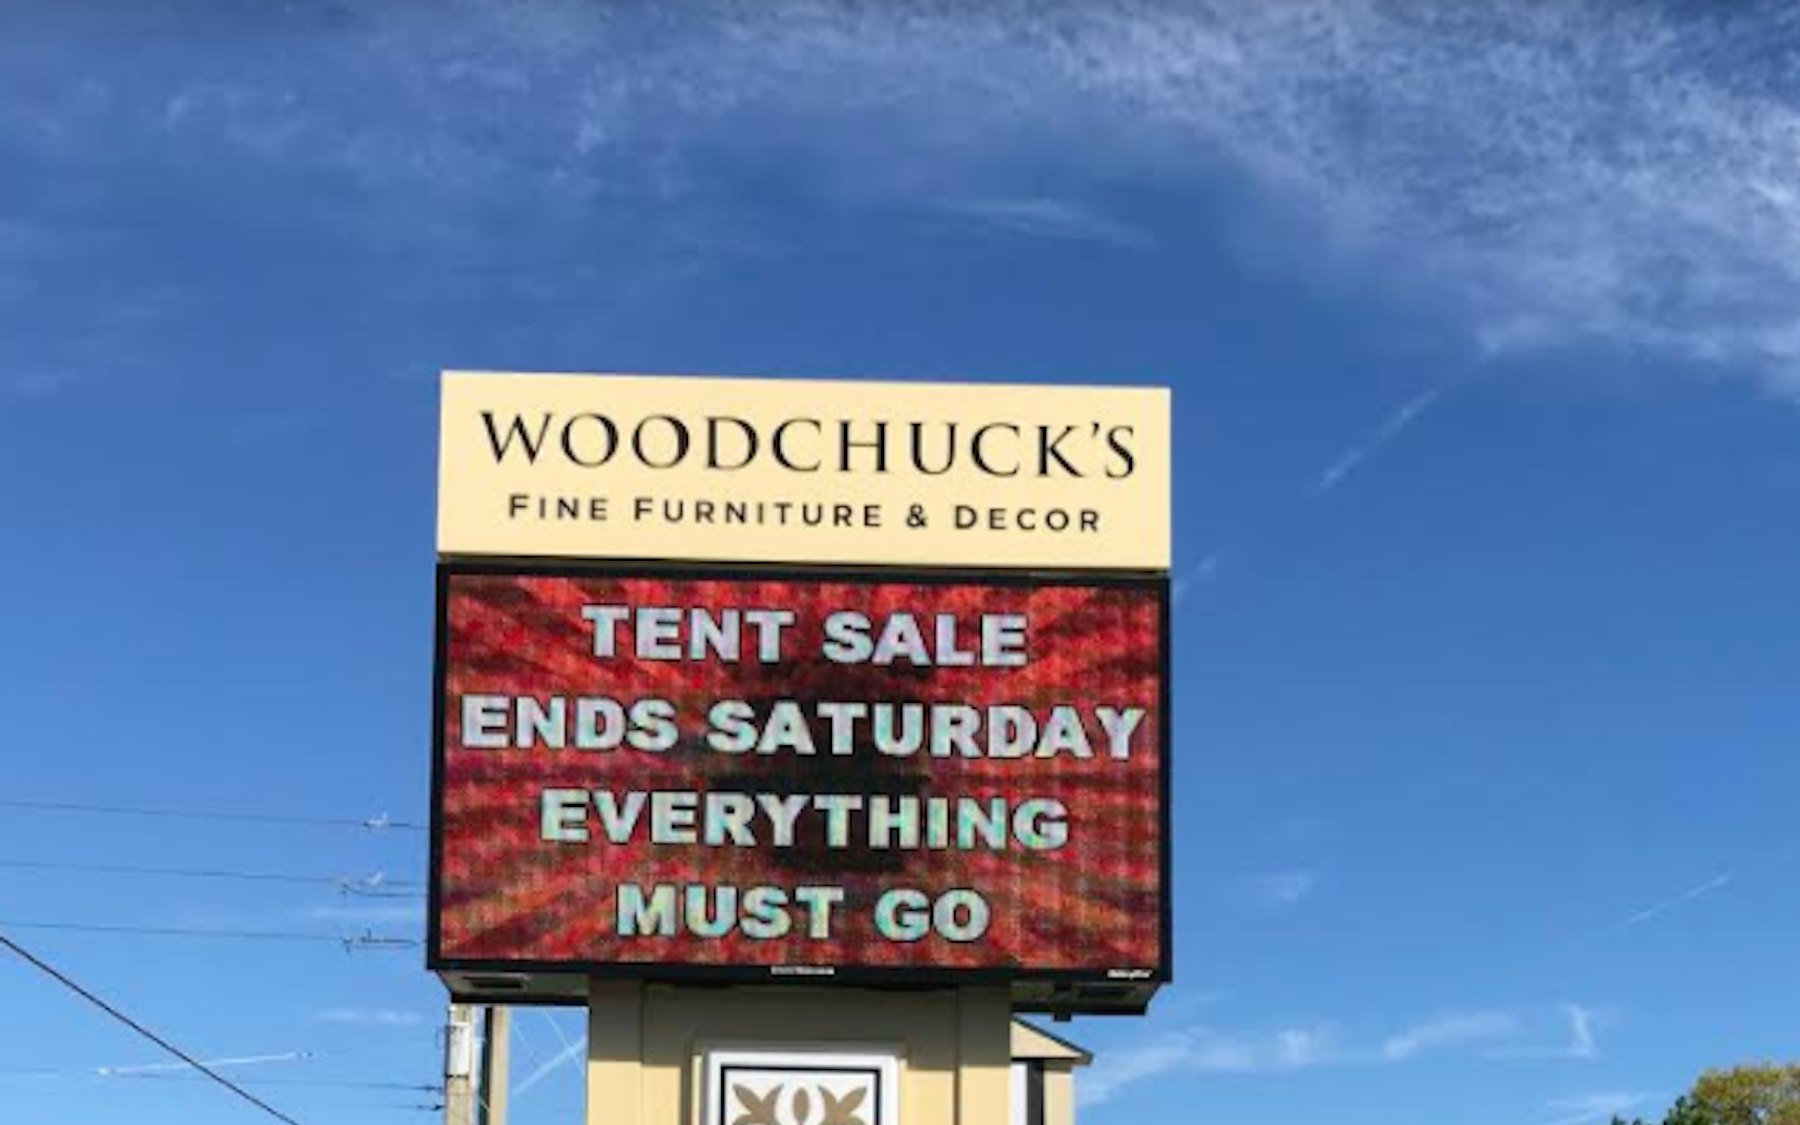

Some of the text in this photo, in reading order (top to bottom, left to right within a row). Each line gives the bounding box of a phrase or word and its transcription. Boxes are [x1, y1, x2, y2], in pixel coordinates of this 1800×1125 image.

[480, 410, 1136, 479] WOODCHUCK'S
[508, 494, 1101, 532] FINE FURNITURE & DECOR
[582, 605, 1029, 667] TENT SALE
[461, 695, 1145, 760] ENDS SATURDAY
[540, 788, 1069, 850] EVERYTHING
[615, 883, 990, 943] MUST GO
